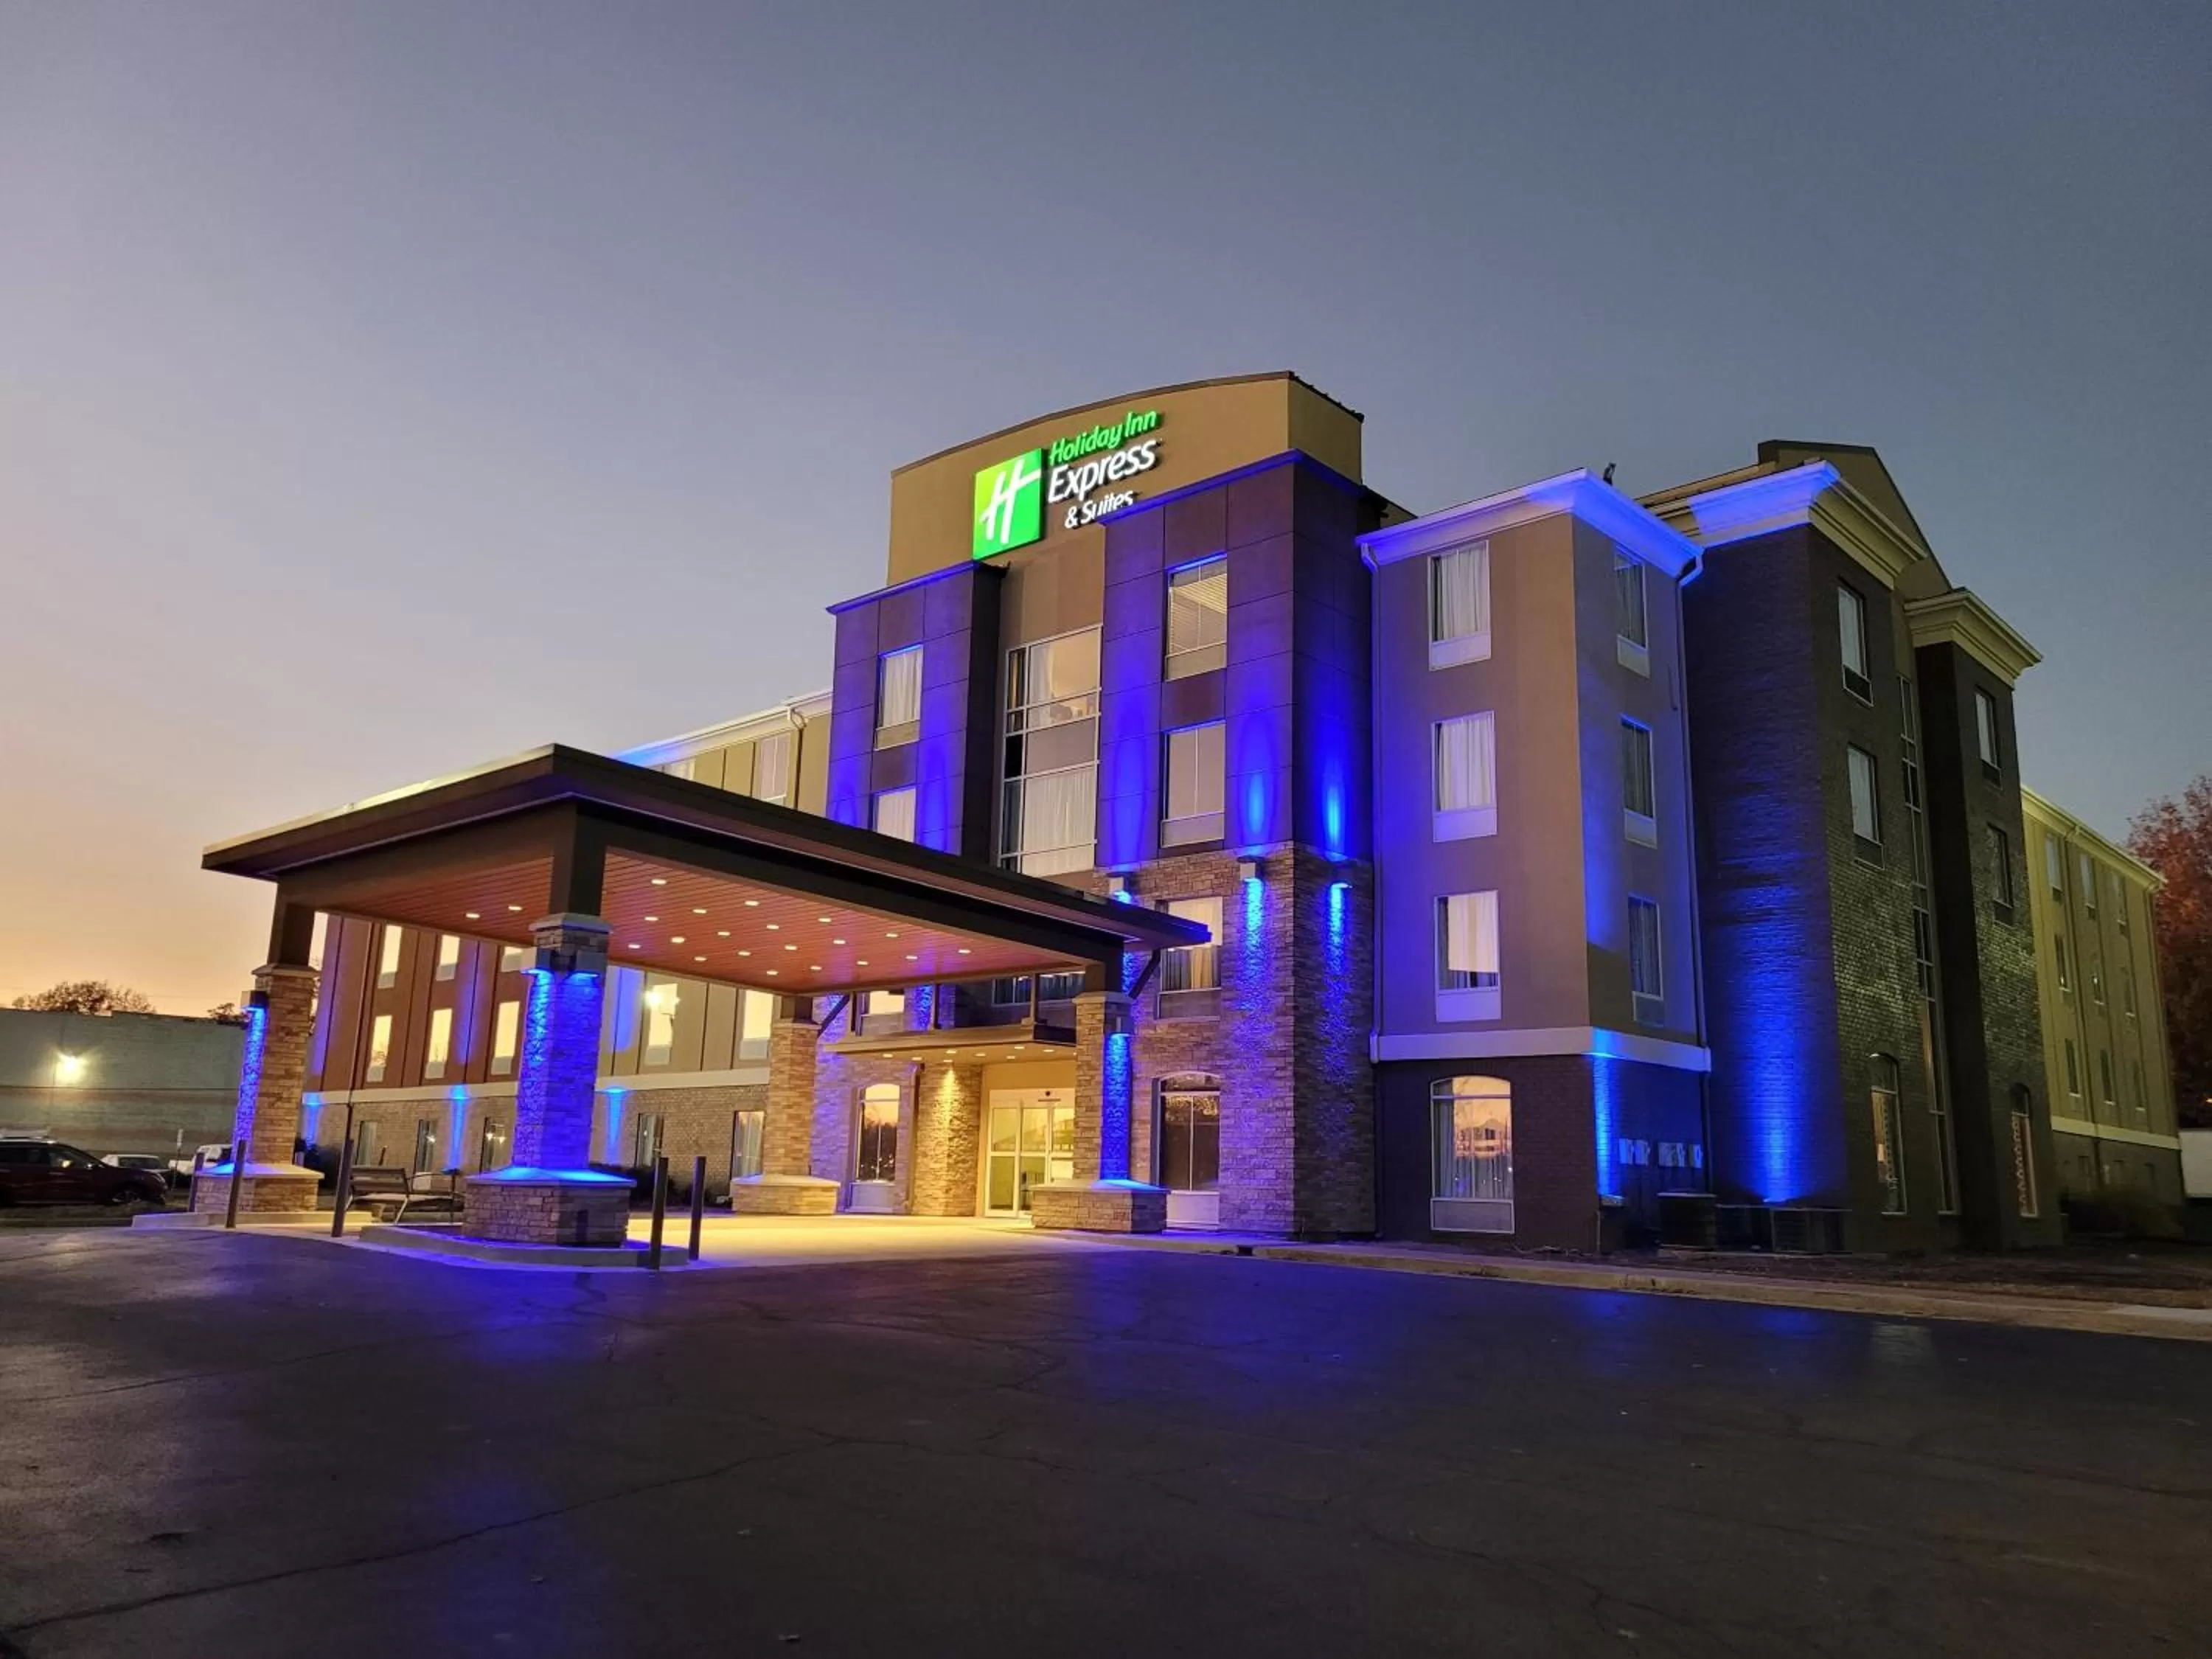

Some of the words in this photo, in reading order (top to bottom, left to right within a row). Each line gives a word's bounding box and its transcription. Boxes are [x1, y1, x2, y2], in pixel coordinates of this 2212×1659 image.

[1049, 422, 1124, 465] Holiday
[1124, 410, 1157, 437] Inn
[1048, 439, 1157, 503] Express
[1064, 505, 1080, 529] &
[1080, 490, 1133, 525] Suites
